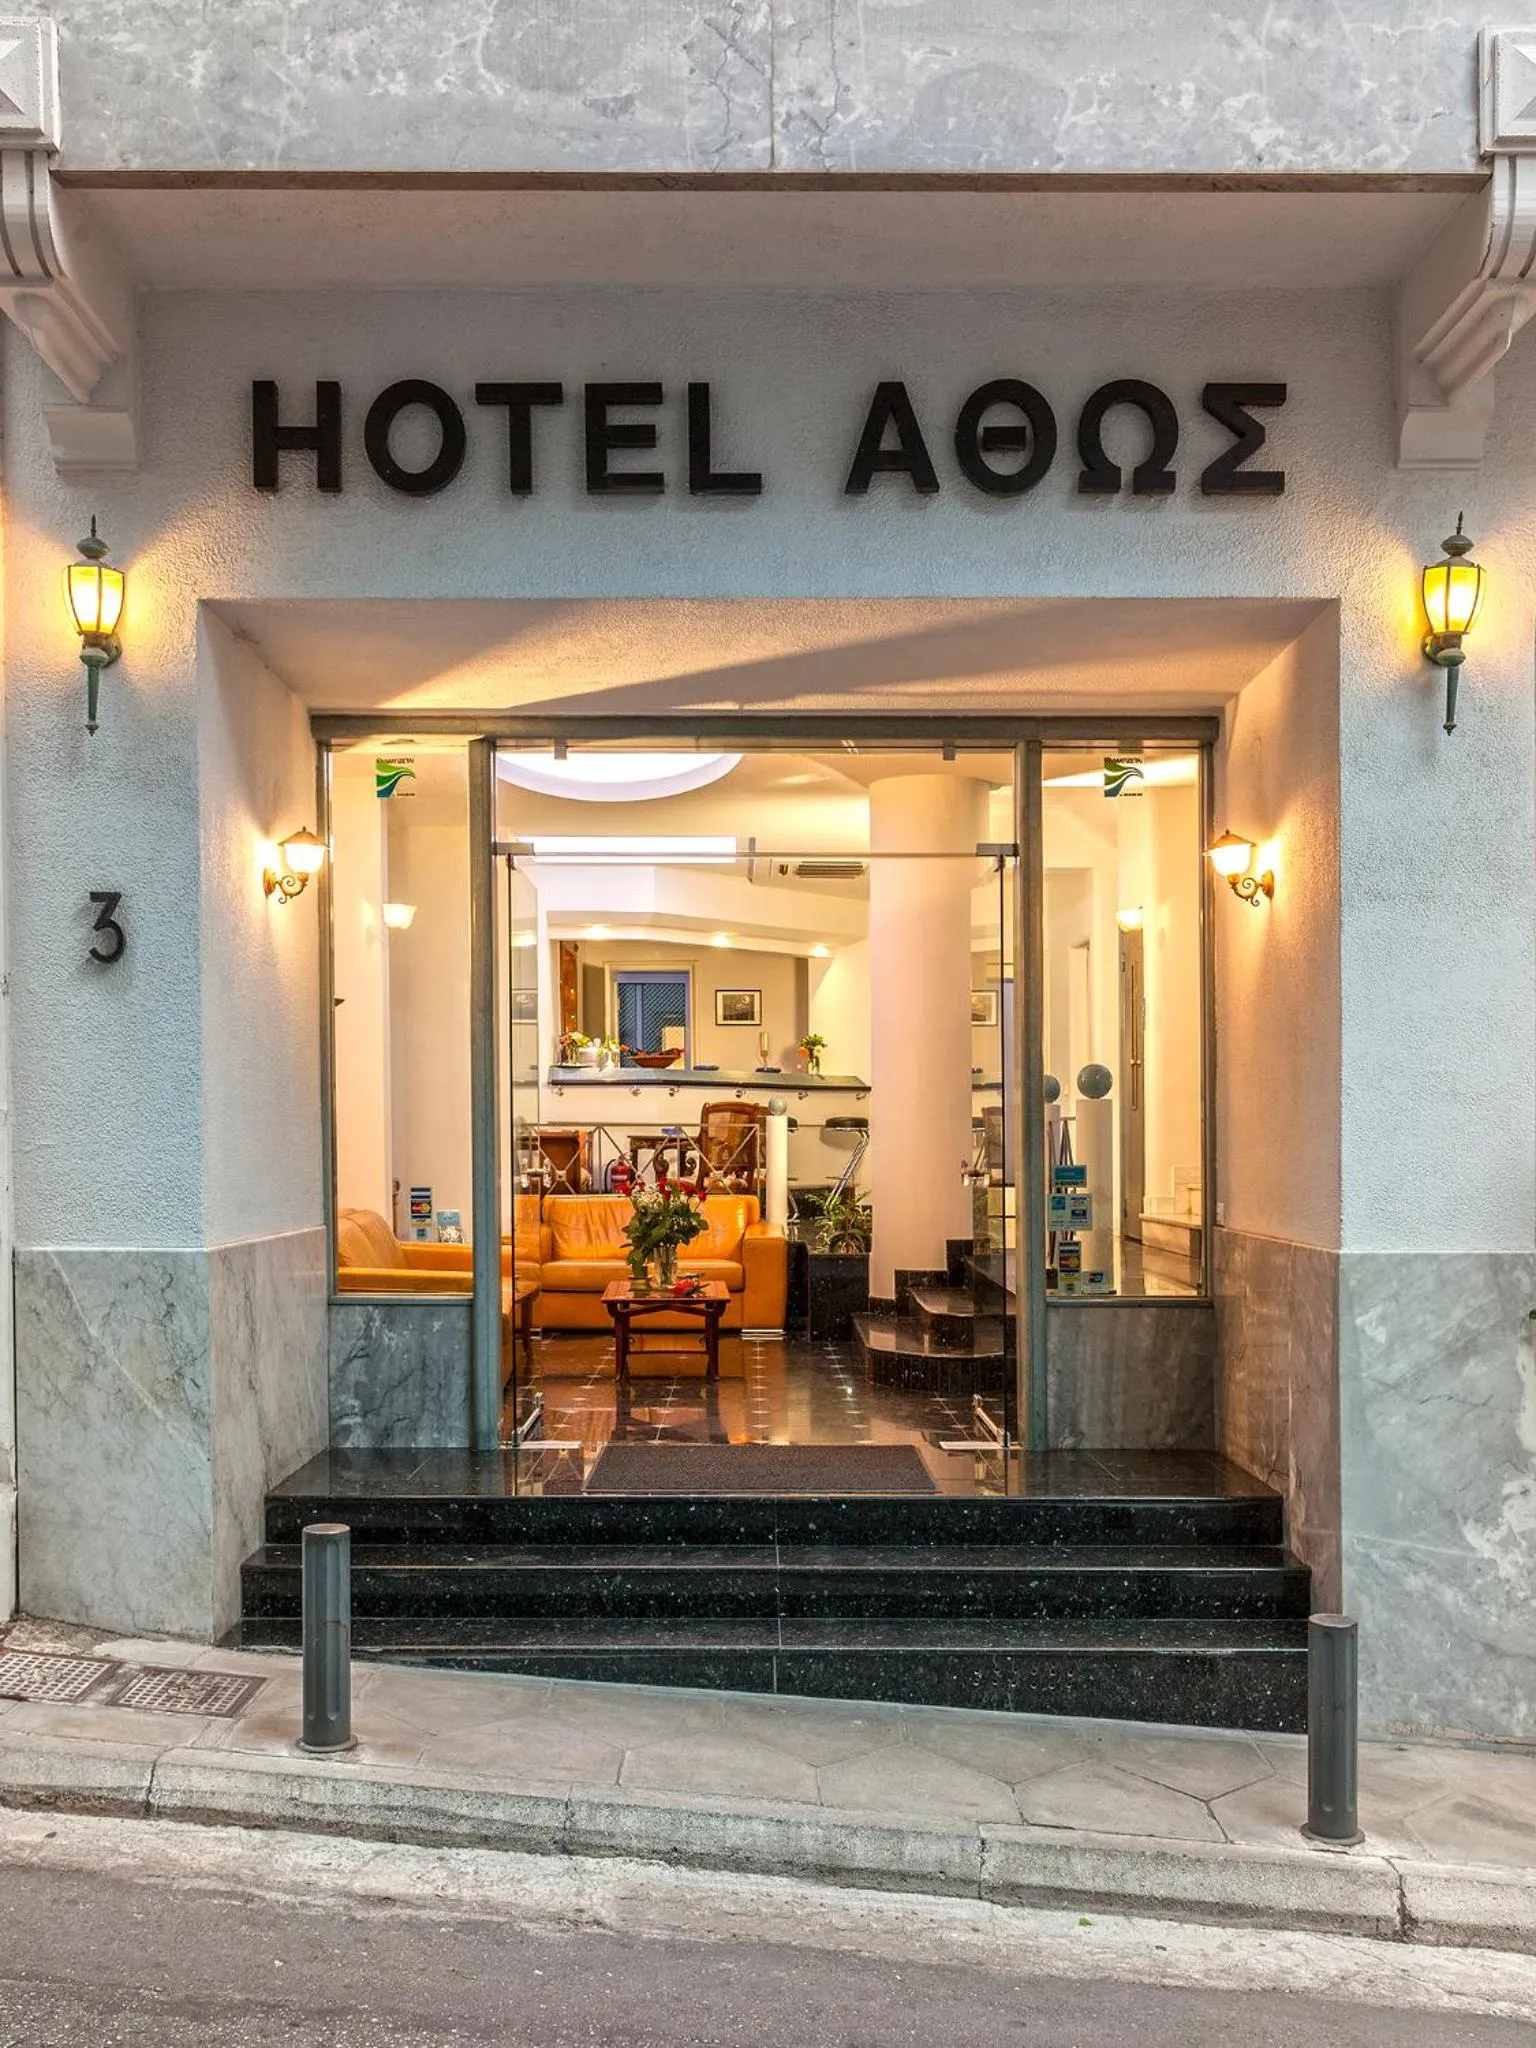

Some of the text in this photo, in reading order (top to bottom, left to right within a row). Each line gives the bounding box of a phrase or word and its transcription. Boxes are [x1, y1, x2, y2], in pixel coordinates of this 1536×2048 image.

[252, 378, 1287, 495] HOTEL ΑΘΩΣ
[89, 892, 124, 964] 3
